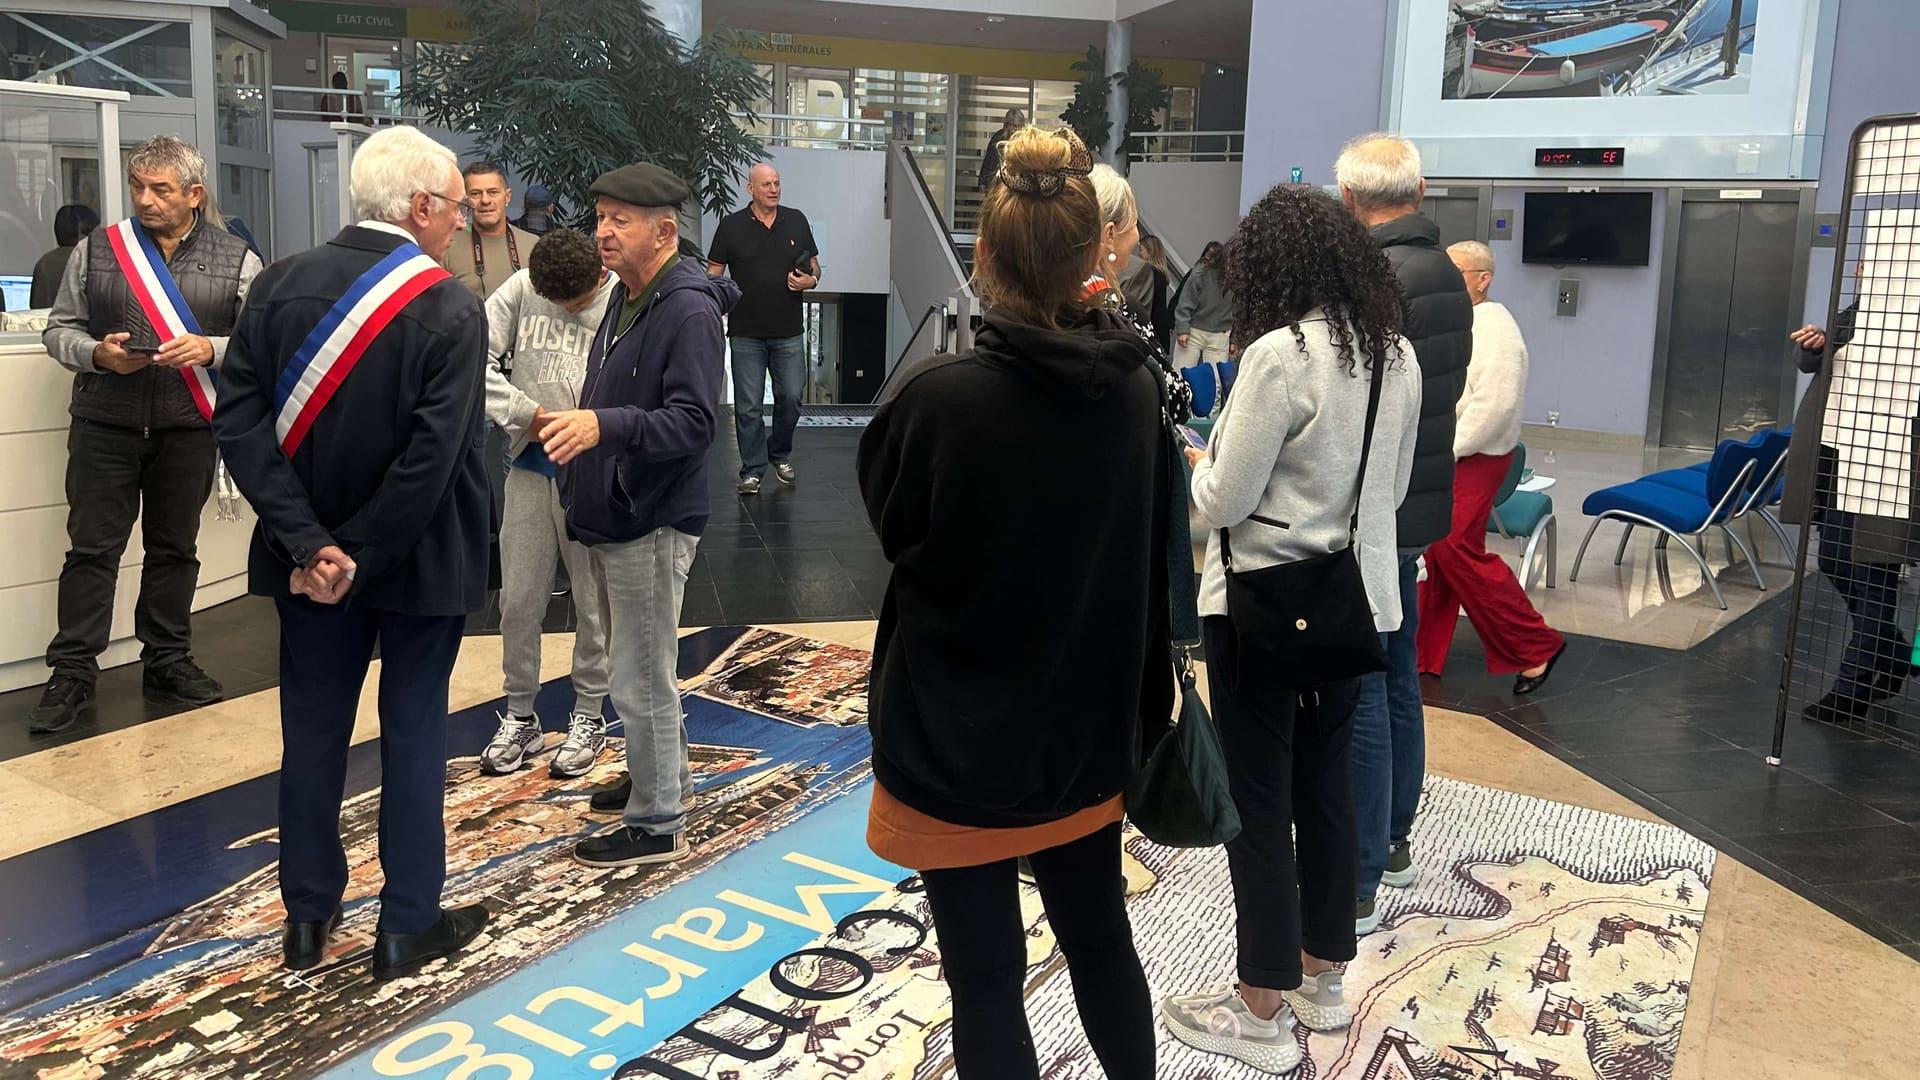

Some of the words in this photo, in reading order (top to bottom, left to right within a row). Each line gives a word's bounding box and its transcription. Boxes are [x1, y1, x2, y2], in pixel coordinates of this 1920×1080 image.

[336, 14, 361, 25] ETAT
[365, 16, 394, 28] CIVIL
[518, 314, 596, 358] YOSEM
